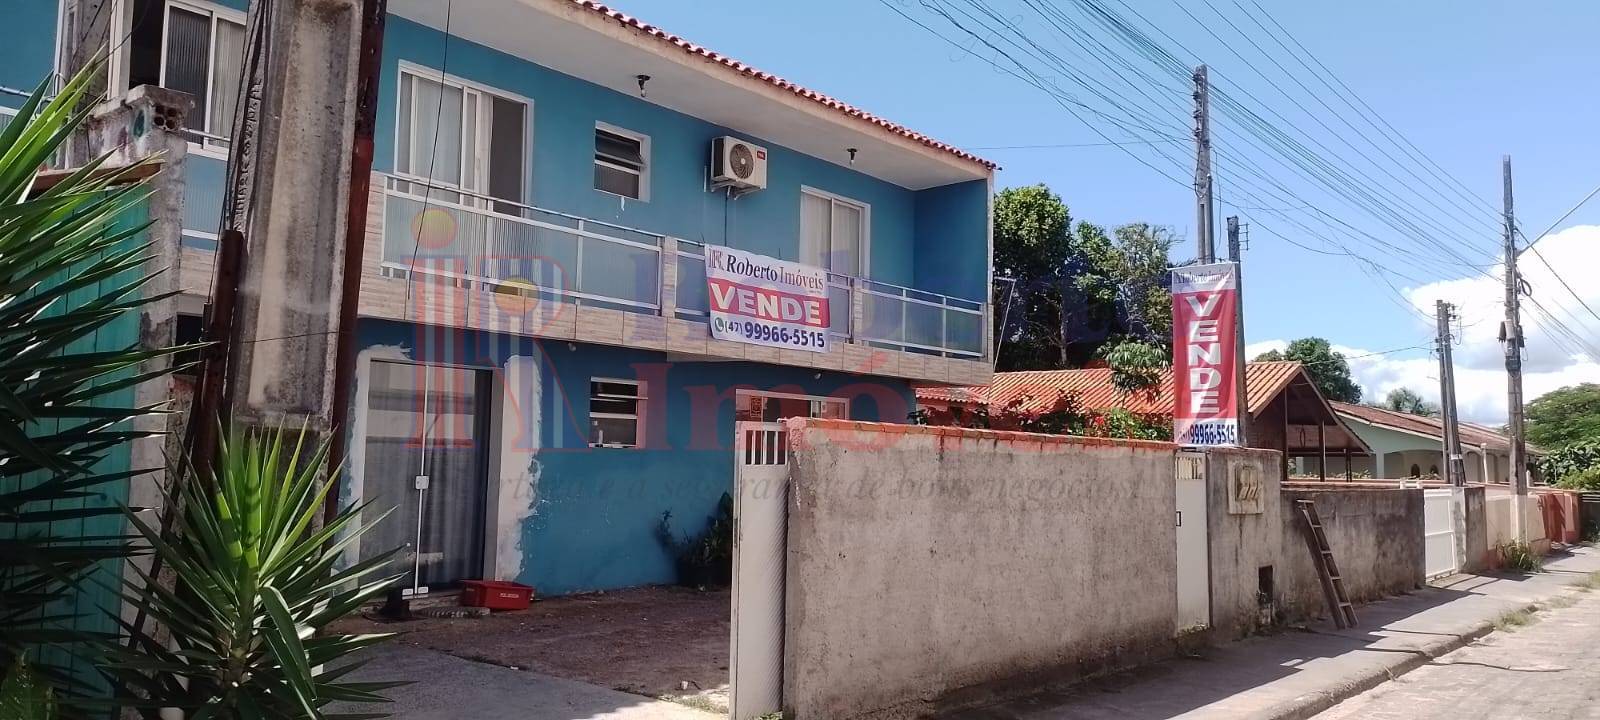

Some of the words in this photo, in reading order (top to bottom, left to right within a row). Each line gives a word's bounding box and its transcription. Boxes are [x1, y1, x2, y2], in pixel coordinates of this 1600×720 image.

[726, 254, 778, 282] Roberto
[779, 266, 824, 290] Imóveis
[710, 282, 822, 325] VENDE
[725, 320, 743, 334] (47)
[744, 321, 825, 348] 99966-5515
[1185, 293, 1222, 415] VENDE
[1190, 423, 1235, 445] 99966-5515
